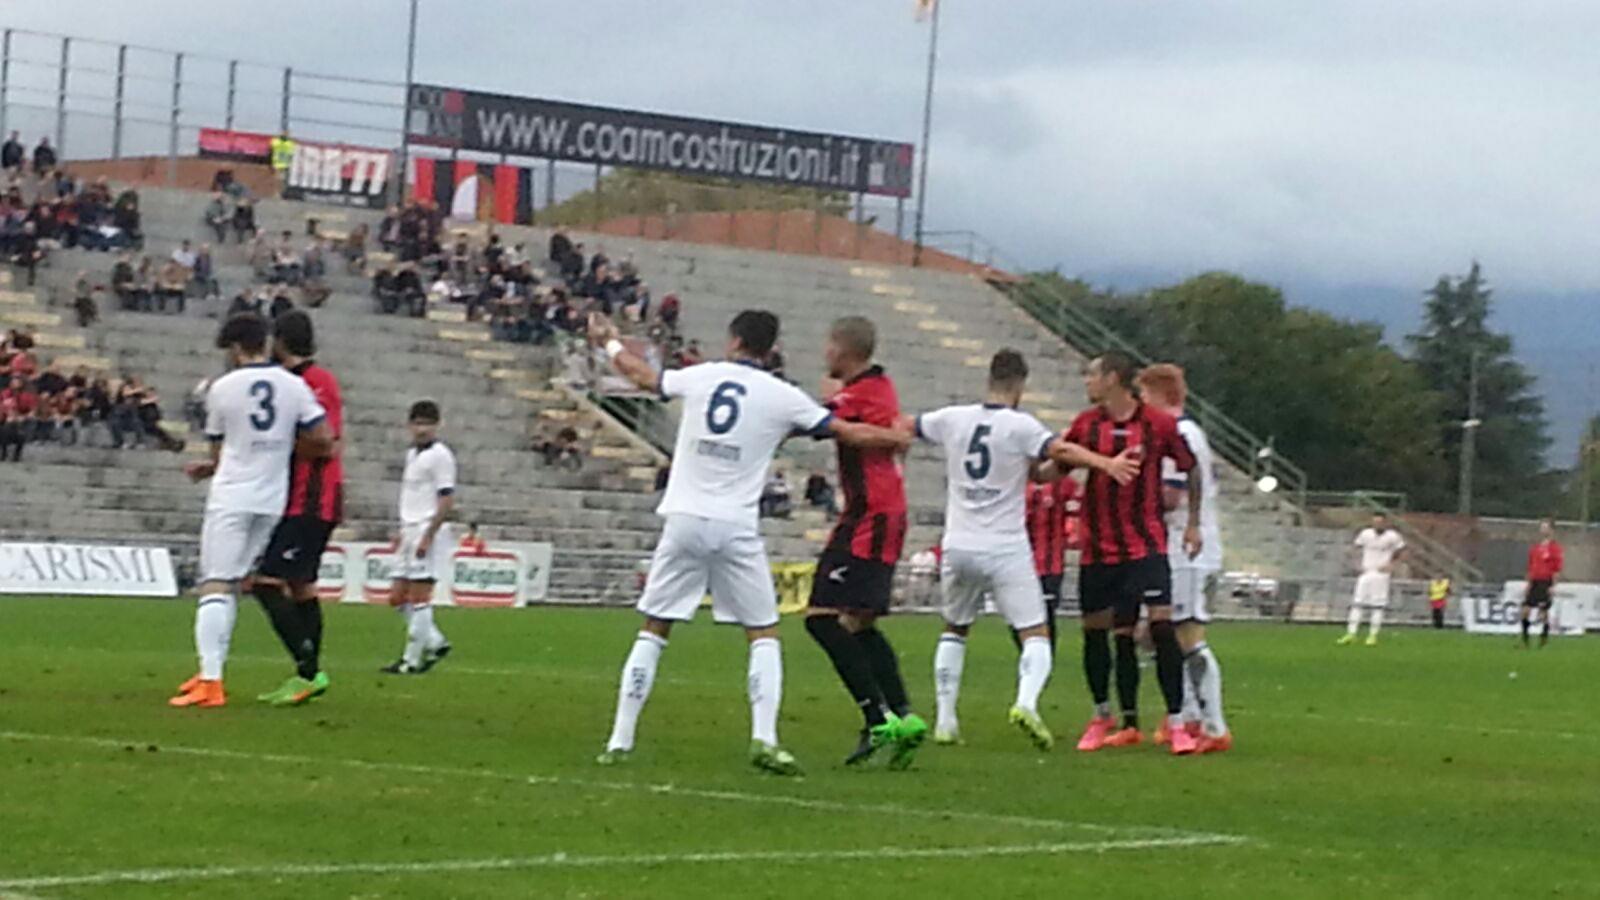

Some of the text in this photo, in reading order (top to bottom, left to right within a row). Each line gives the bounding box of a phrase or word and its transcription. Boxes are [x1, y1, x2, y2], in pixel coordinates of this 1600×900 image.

[476, 107, 861, 186] www.coamcostruzioni.it
[249, 380, 276, 432] 3
[706, 381, 747, 435] 6
[964, 424, 992, 480] 5
